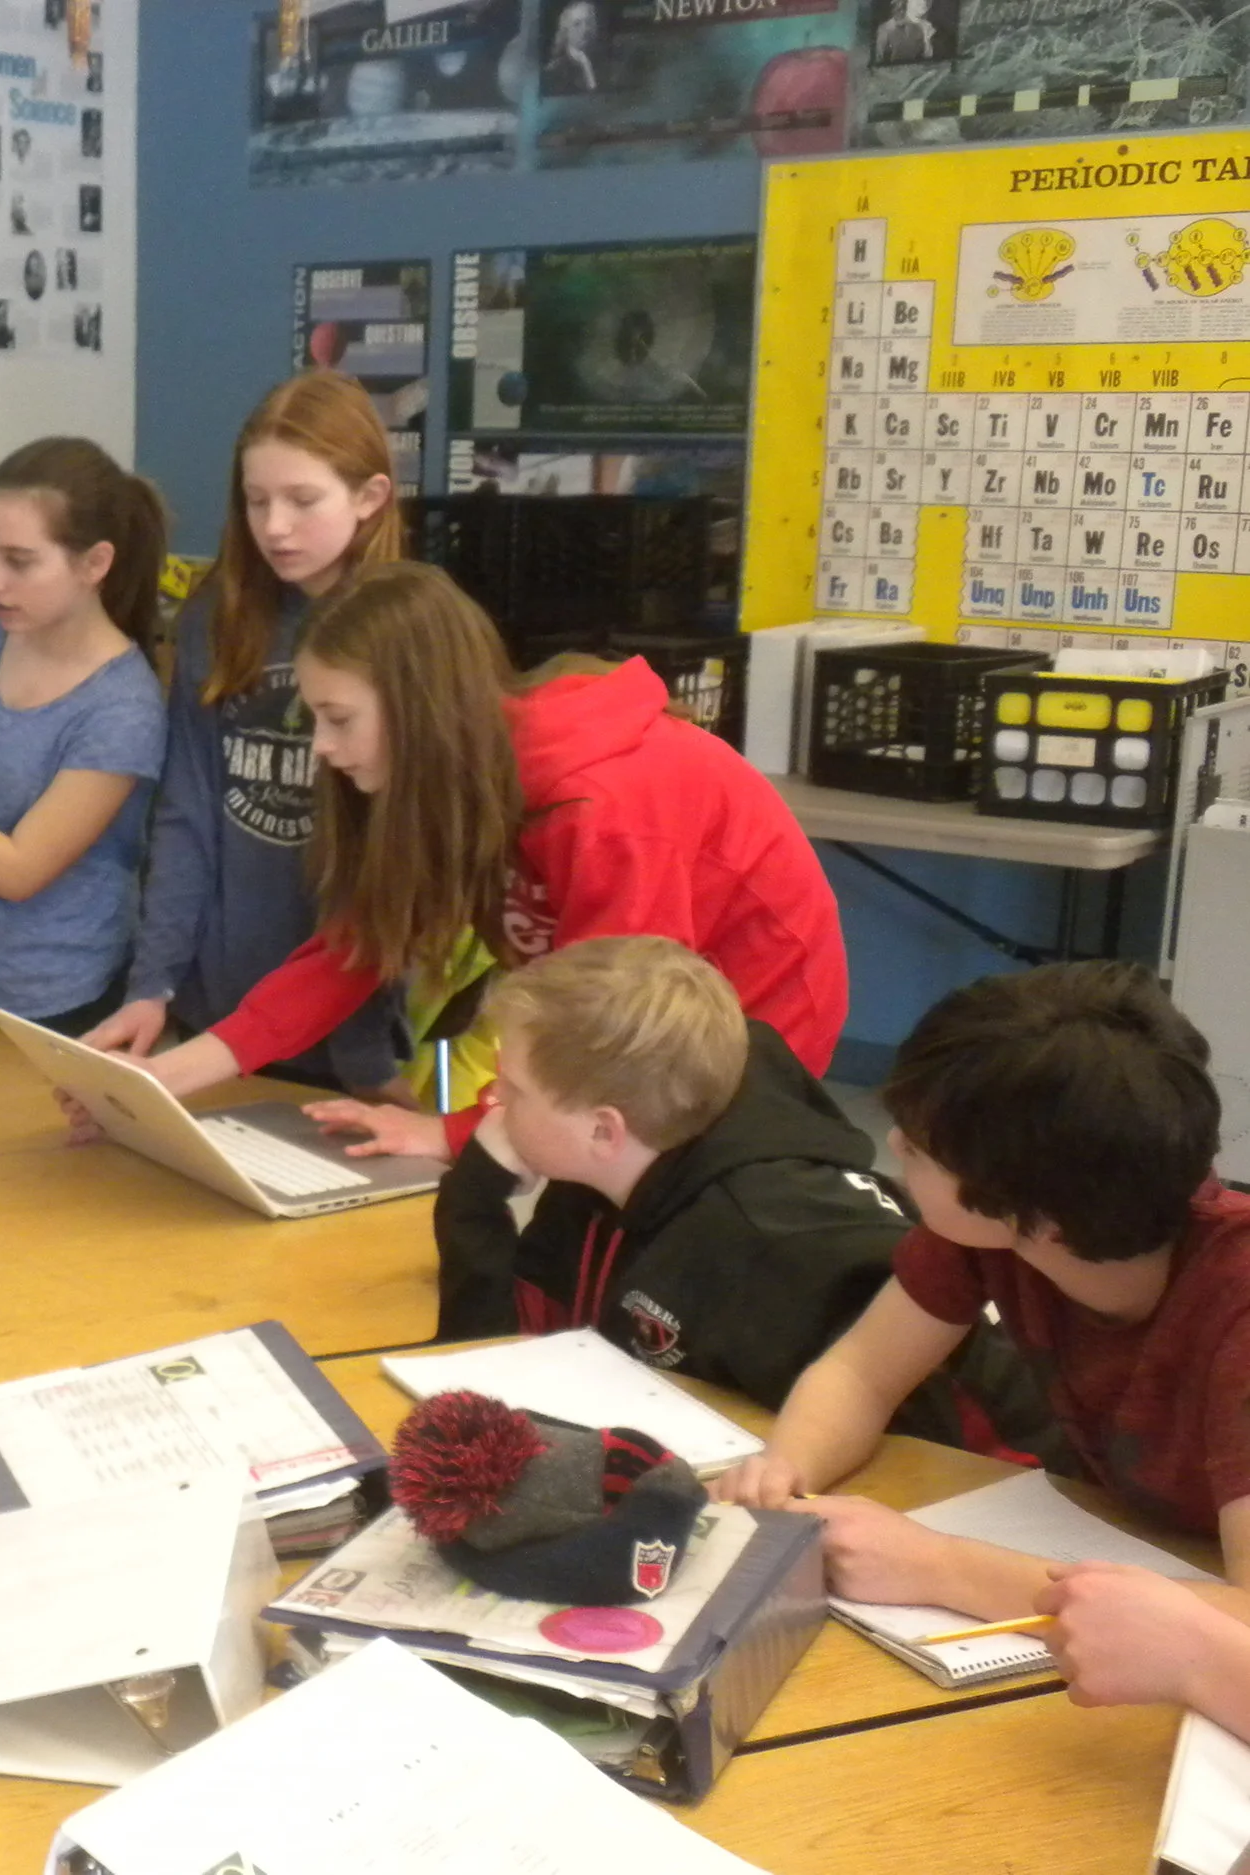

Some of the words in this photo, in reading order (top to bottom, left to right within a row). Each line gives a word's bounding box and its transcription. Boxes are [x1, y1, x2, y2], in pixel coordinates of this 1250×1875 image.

[362, 20, 449, 53] GALILEI
[10, 87, 77, 126] Science
[1009, 159, 1182, 193] PERIODIC
[1192, 155, 1250, 183] TA
[857, 196, 870, 213] IA
[853, 239, 867, 263] H
[901, 257, 920, 274] IIA
[452, 252, 480, 360] OBSERVE
[847, 301, 865, 324] Li
[894, 300, 919, 324] Be
[364, 323, 425, 345] QUESTION
[841, 356, 864, 379] Na
[888, 356, 919, 383] Mg
[993, 371, 1016, 388] IVB
[1048, 370, 1065, 388] VB
[1099, 370, 1122, 388] VIB
[1152, 369, 1180, 388] VIIB
[1085, 397, 1097, 411] 24
[1139, 397, 1152, 411] 25
[1196, 397, 1209, 411] 26
[845, 413, 857, 436] K
[885, 412, 910, 436] Ca
[936, 412, 960, 437] Sc
[988, 413, 1008, 437] Ti
[1046, 413, 1059, 438] V
[1094, 412, 1118, 438] Cr
[1144, 412, 1179, 438] Mn
[1205, 412, 1233, 438] Fe
[1078, 456, 1091, 470] 42
[1132, 457, 1145, 471] 43
[1189, 457, 1202, 471] 44
[837, 467, 862, 490] Rb
[886, 468, 906, 491] Sr
[940, 468, 952, 492] Y
[984, 469, 1007, 493] Zr
[1034, 470, 1060, 496] Nb
[1083, 471, 1117, 496] Mo
[1141, 472, 1166, 497] Tc
[1198, 474, 1228, 500] Ru
[832, 520, 854, 543] Cs
[1073, 513, 1085, 527] 74
[1128, 515, 1141, 529] 75
[1184, 517, 1198, 531] 76
[879, 521, 903, 545] Ba
[980, 524, 1004, 549] Hf
[1030, 527, 1053, 551] Ta
[1085, 530, 1106, 555] W
[1136, 531, 1166, 557] Re
[1193, 533, 1221, 560] Os
[829, 575, 848, 598] Fr
[876, 577, 899, 601] Ra
[1121, 572, 1139, 587] 107
[971, 579, 1005, 606] Unq
[1020, 582, 1056, 609] Unp
[1071, 585, 1109, 611] Unh
[1124, 587, 1161, 614] Uns
[1228, 646, 1242, 661] 62
[1234, 662, 1250, 688] S
[222, 734, 275, 782] PARK
